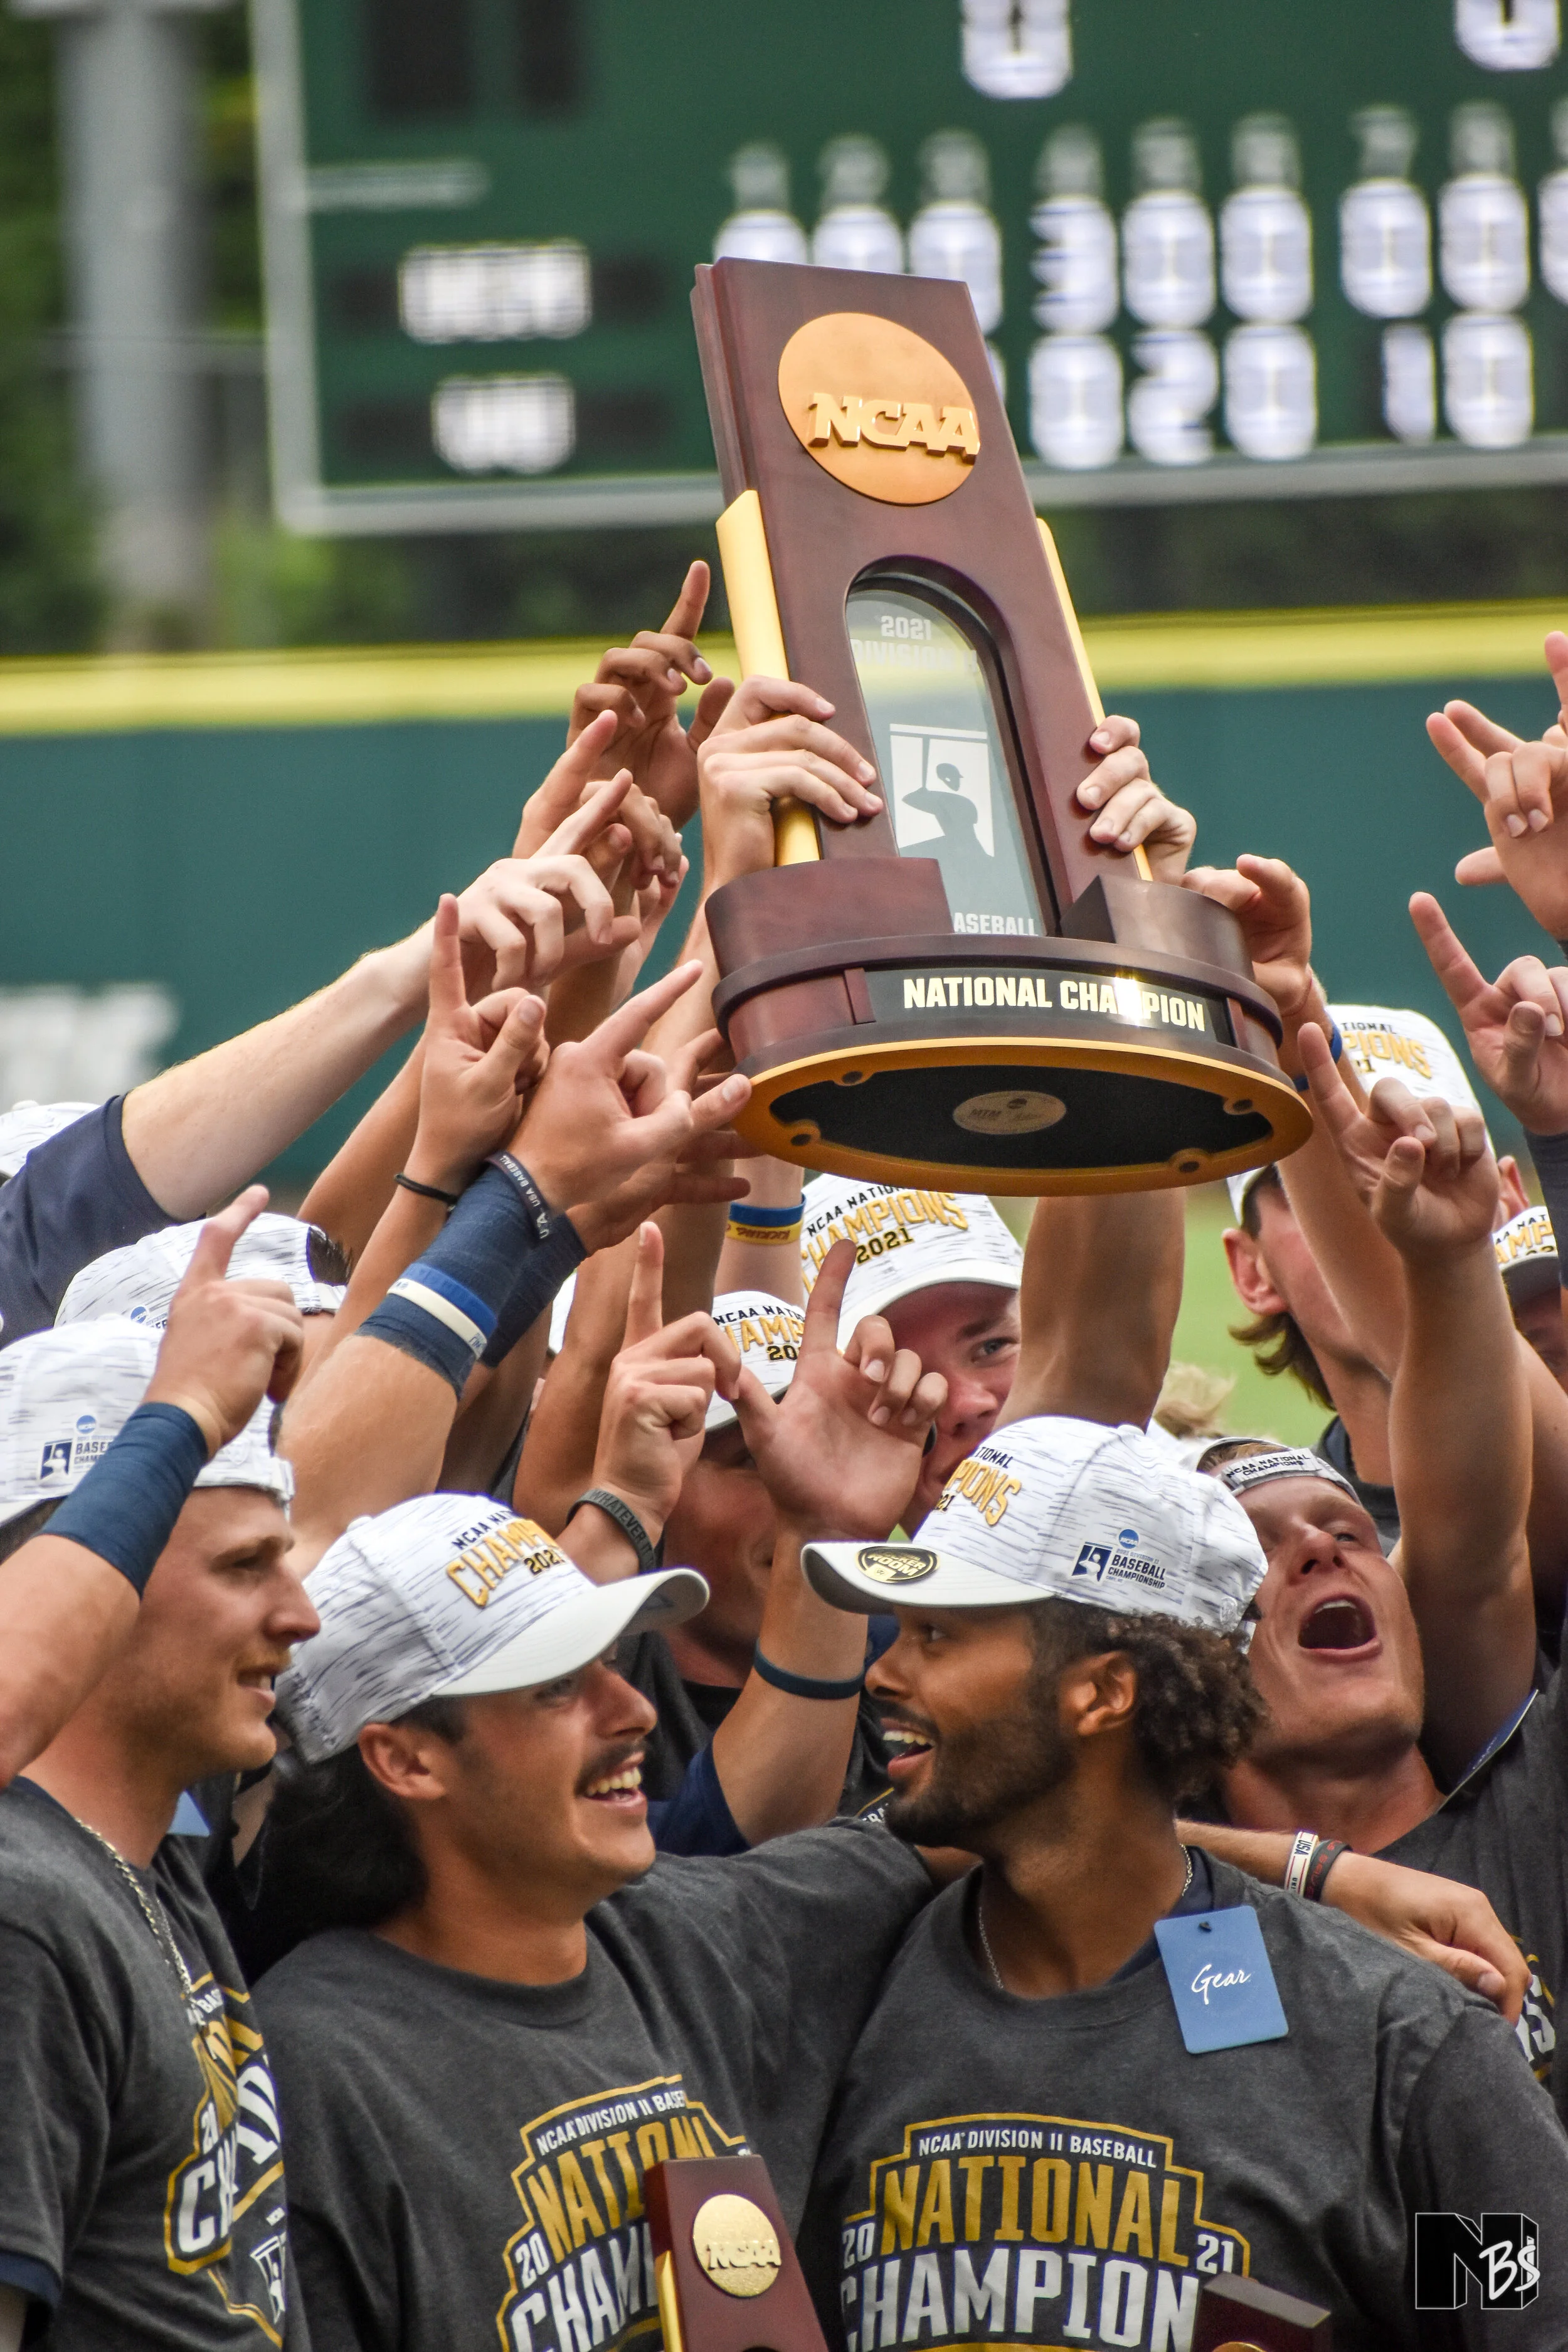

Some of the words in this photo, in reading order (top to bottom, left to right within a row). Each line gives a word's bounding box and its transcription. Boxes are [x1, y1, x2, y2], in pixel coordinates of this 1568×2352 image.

[808, 393, 981, 465] NCAA
[880, 615, 933, 641] 2021
[953, 912, 1039, 936] ASEBALL
[903, 976, 1053, 1009] NATIONAL
[1059, 980, 1206, 1032] CHAPION
[499, 1155, 529, 1187] BASEBALL
[807, 1205, 843, 1237] NCAA
[856, 1226, 915, 1265] 2021
[712, 1307, 760, 1326] NCAA
[1226, 1463, 1257, 1479] NCAA
[1259, 1453, 1311, 1466] NATIONAL
[1243, 1460, 1305, 1476] CHAMPIONS
[451, 1522, 492, 1550] NCAA
[1108, 1567, 1165, 1589] CHAMPIONSHIP
[1111, 1554, 1166, 1581] BASEBALL
[1294, 1839, 1313, 1856] USA
[1191, 1964, 1251, 2005] Gear
[575, 2101, 639, 2136] DIVISION
[637, 2098, 654, 2116] II
[918, 2132, 962, 2157] NCAA
[968, 2129, 1043, 2150] DIVISION
[1049, 2132, 1064, 2151] II
[1069, 2134, 1157, 2169] BASEBALL
[880, 2155, 1190, 2267] NATIONAL
[514, 2232, 550, 2290] 20
[707, 2239, 781, 2272] NCAA
[842, 2222, 876, 2270] 20
[1196, 2233, 1234, 2274] 21
